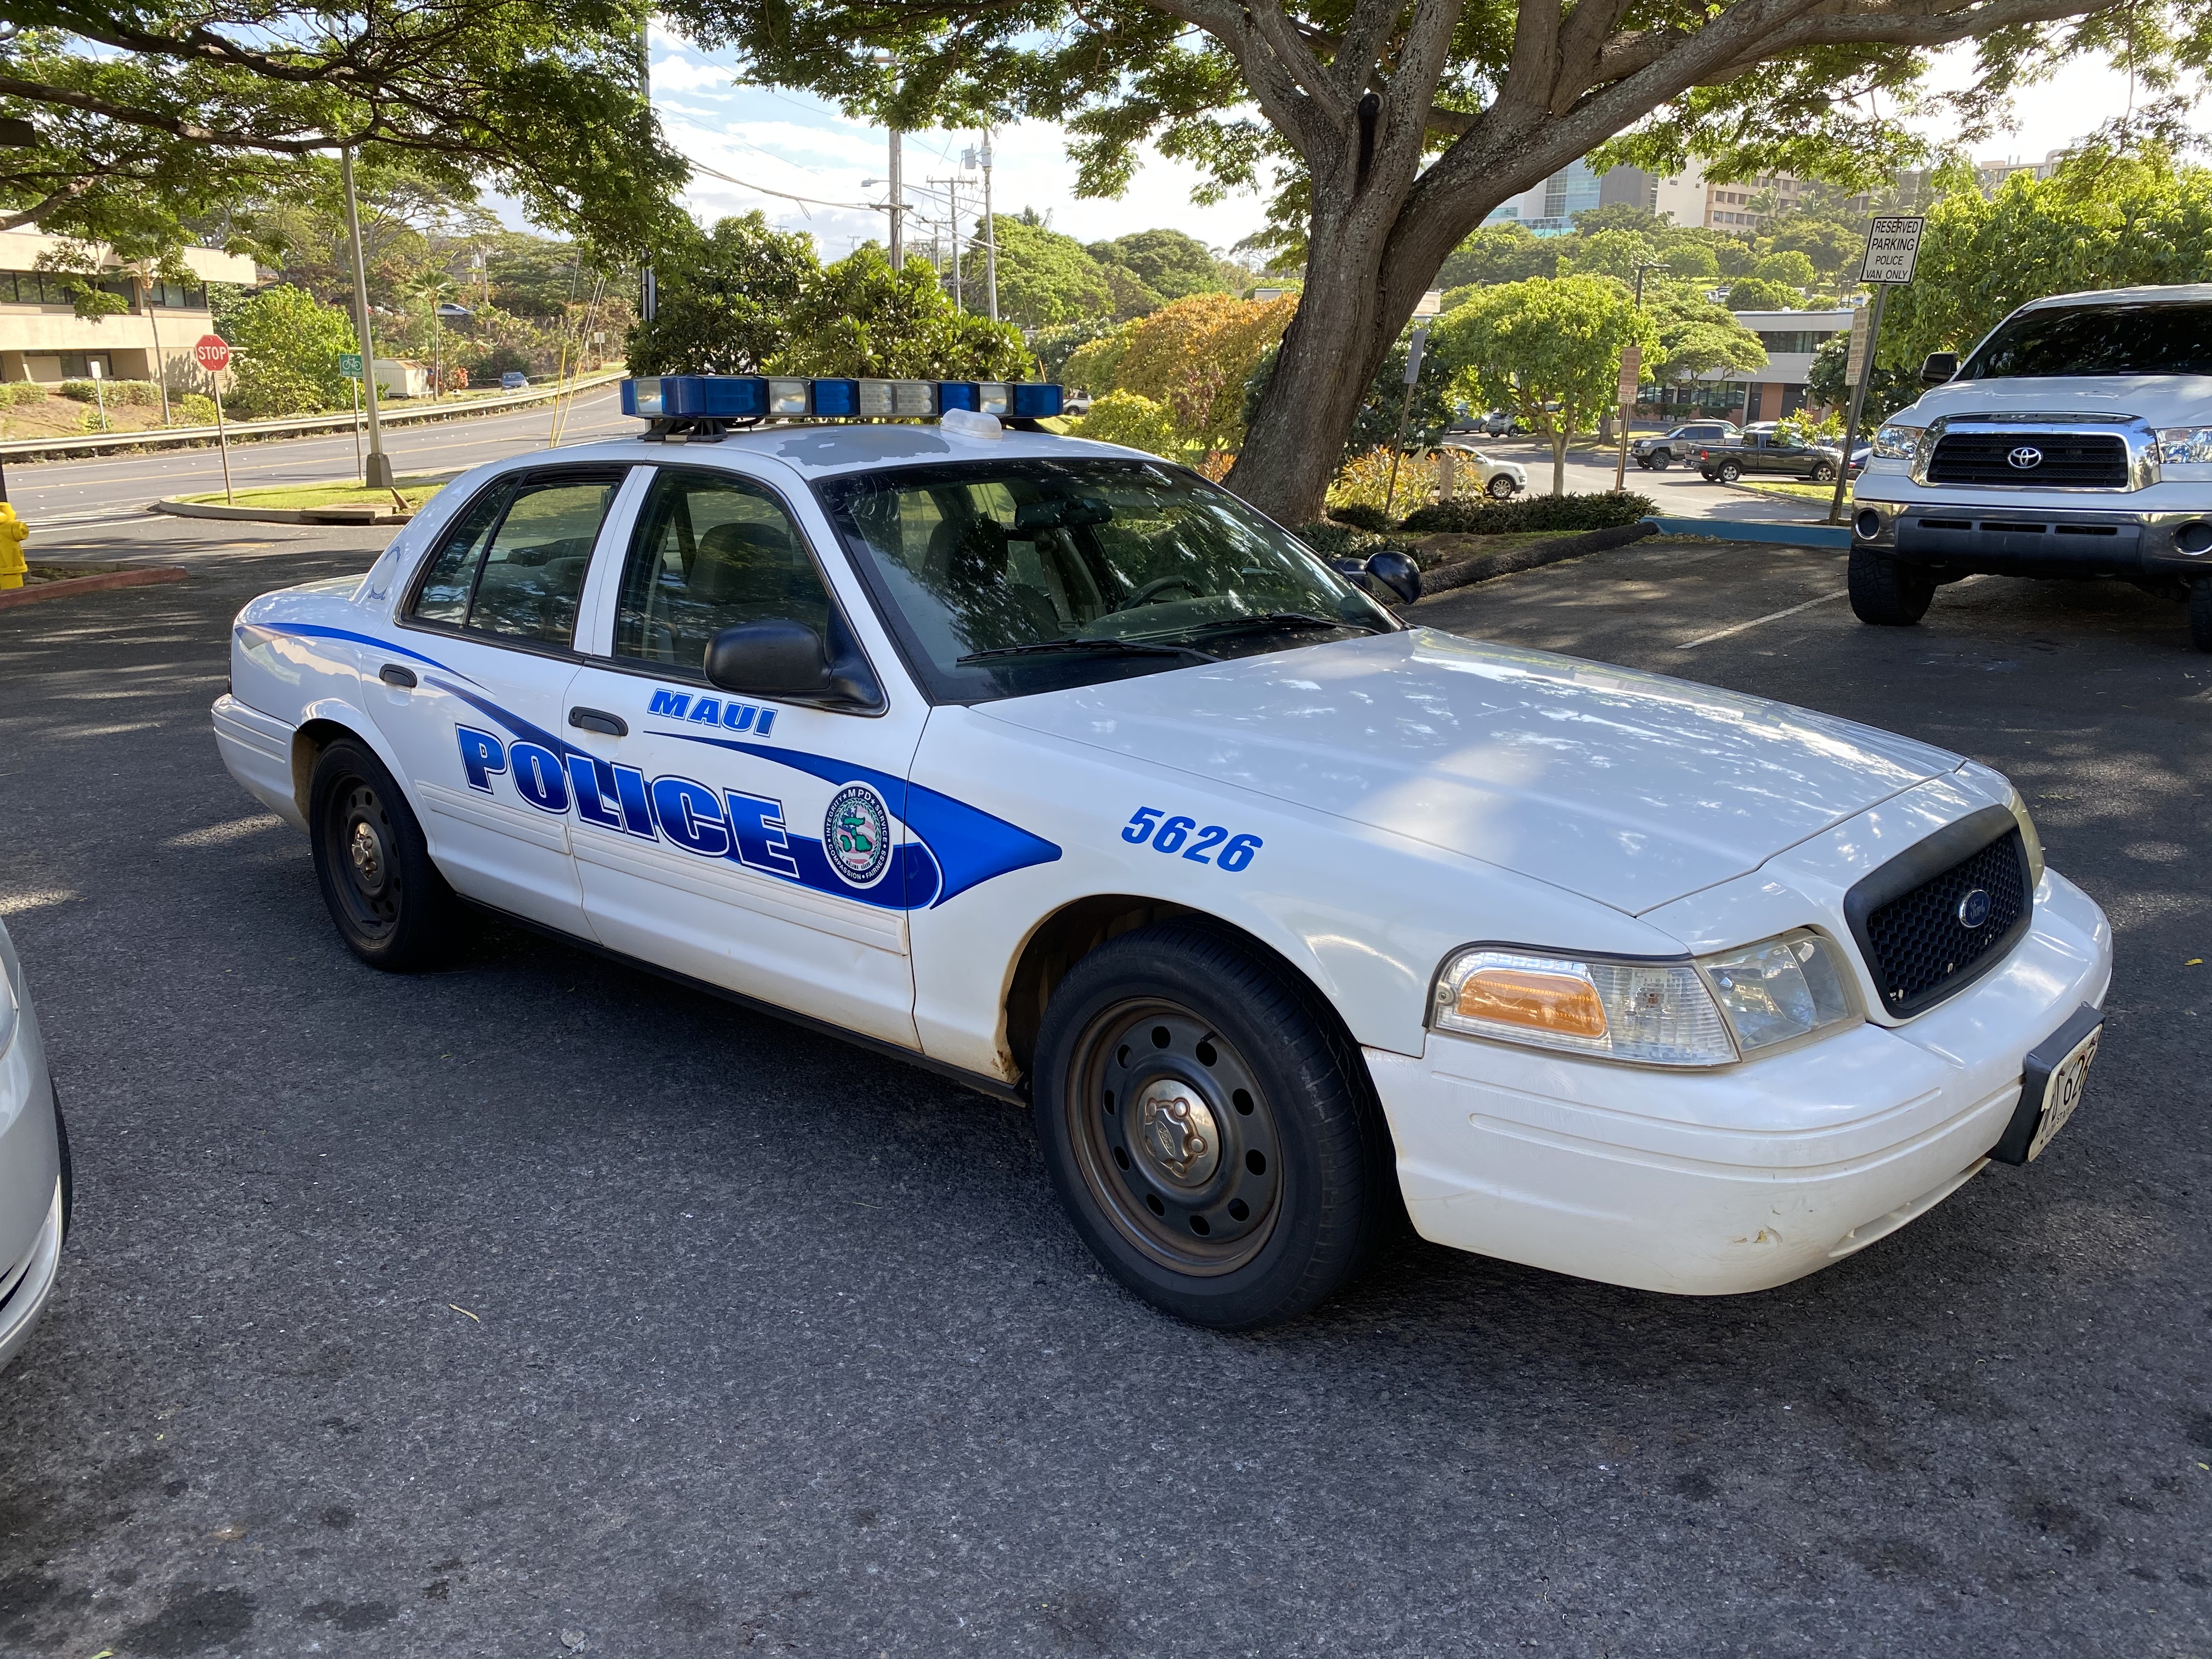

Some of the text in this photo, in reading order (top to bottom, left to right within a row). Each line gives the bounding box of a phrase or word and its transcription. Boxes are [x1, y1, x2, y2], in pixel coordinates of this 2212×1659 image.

[1875, 221, 1918, 233] RESERVED
[1871, 238, 1915, 251] PARKING
[1875, 256, 1904, 265] POLICE
[1866, 270, 1908, 279] VAN ONLY
[198, 346, 227, 360] STOP
[647, 689, 778, 738] MAUI
[455, 723, 799, 878] POLICE
[848, 788, 871, 800] MPD
[826, 797, 843, 837] INTEGRITY
[874, 804, 888, 843] SERVICE
[1121, 806, 1263, 872] 5626
[829, 844, 862, 880] COMPASSION
[865, 850, 887, 879] FAIRNESS
[1971, 899, 1985, 919] Ford
